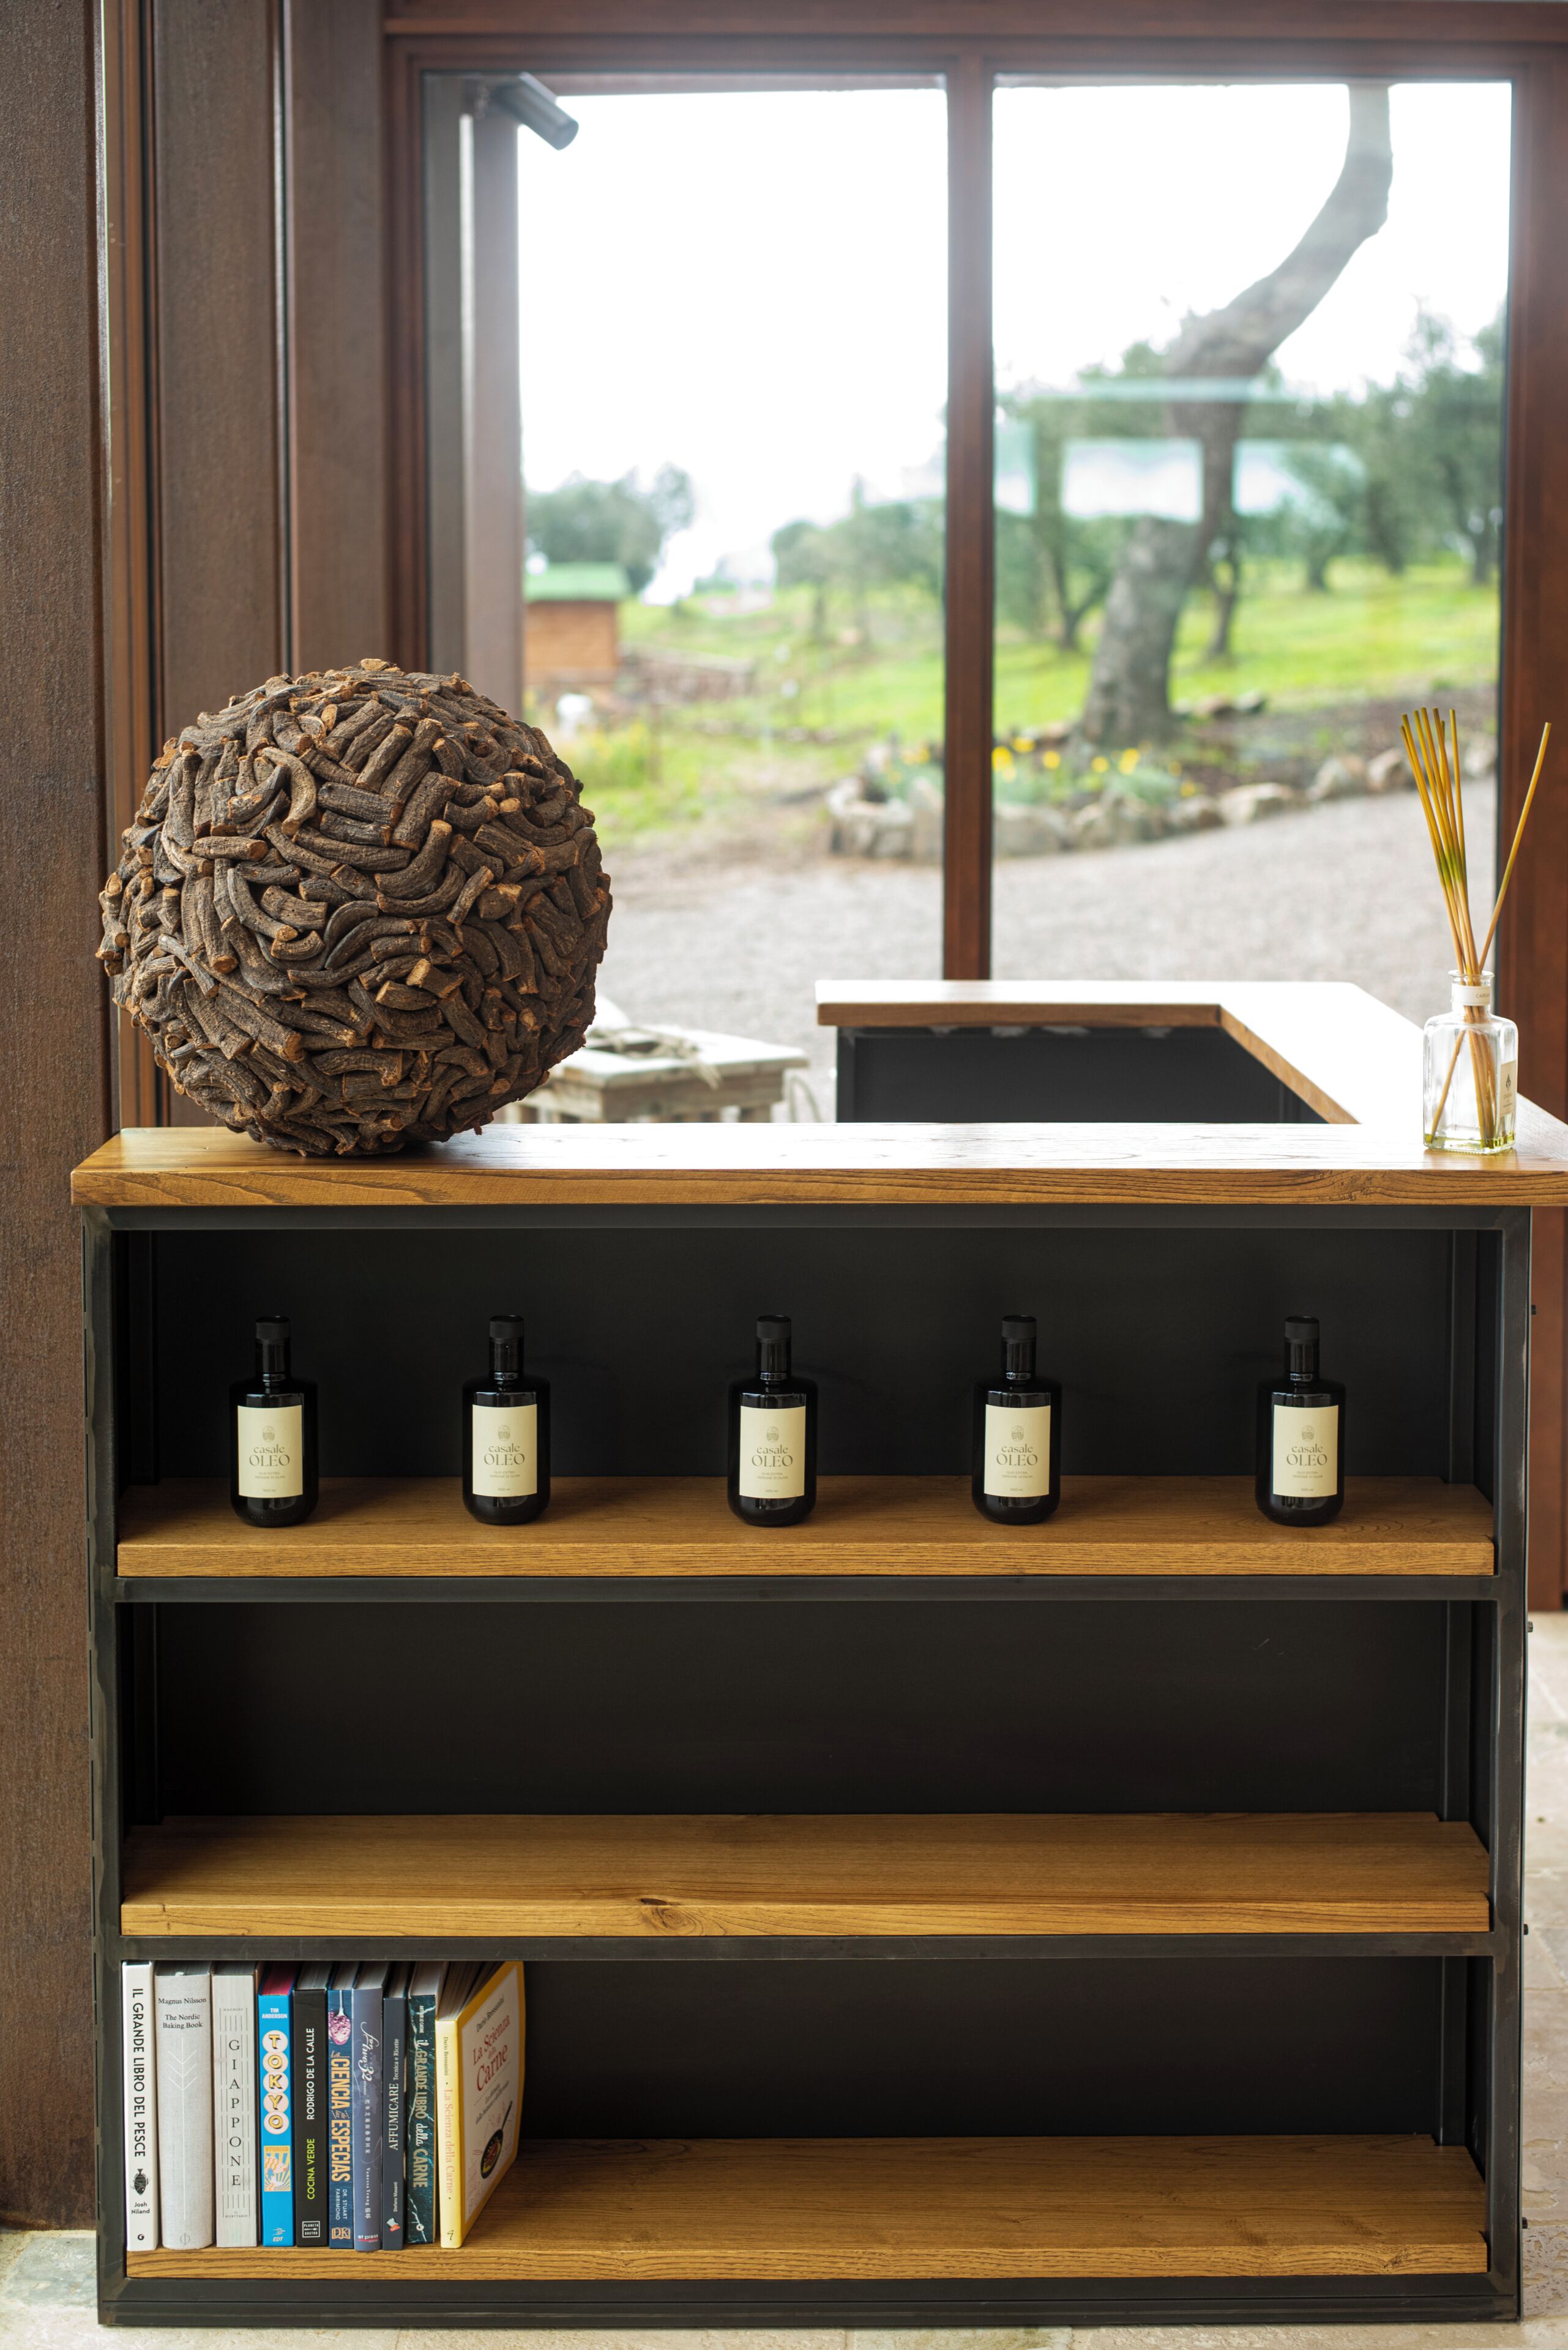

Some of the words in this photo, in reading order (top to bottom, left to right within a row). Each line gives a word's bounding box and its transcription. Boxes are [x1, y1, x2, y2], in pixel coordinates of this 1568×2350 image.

[253, 1444, 285, 1453] casale
[488, 1443, 520, 1452] casale
[756, 1445, 788, 1454] casale
[1001, 1444, 1033, 1453] casale
[1291, 1444, 1323, 1453] casale
[249, 1454, 290, 1466] OLEO
[484, 1453, 525, 1466] OLEO
[752, 1455, 793, 1467] OLEO
[996, 1454, 1038, 1466] OLEO
[1286, 1454, 1327, 1466] OLEO
[133, 1988, 143, 1998] IL
[133, 2002, 144, 2053] GRANDE
[306, 2027, 315, 2053] CALLE
[473, 2046, 483, 2066] La
[484, 2015, 510, 2052] Scienza
[307, 2055, 315, 2066] LA
[358, 2060, 374, 2081] 32
[416, 2051, 428, 2089] GRANDE
[477, 2045, 508, 2092] Carne
[133, 2057, 145, 2092] LIBRO
[267, 2034, 283, 2129] TOKYO
[307, 2068, 315, 2079] DE
[331, 2058, 350, 2109] CIENCIA
[415, 2091, 427, 2119] LIBRO
[444, 2089, 452, 2101] La
[134, 2097, 145, 2117] DEL
[228, 2039, 242, 2186] GIAPPONE
[389, 2083, 398, 2150] AFFUMICARE
[445, 2103, 454, 2138] Scienza
[134, 2122, 146, 2157] PESCE
[416, 2123, 428, 2146] della
[331, 2119, 351, 2182] ESPECIAS
[446, 2140, 454, 2163] della
[413, 2148, 428, 2188] CARNE
[446, 2165, 455, 2193] Carne
[334, 2228, 349, 2237] DK
